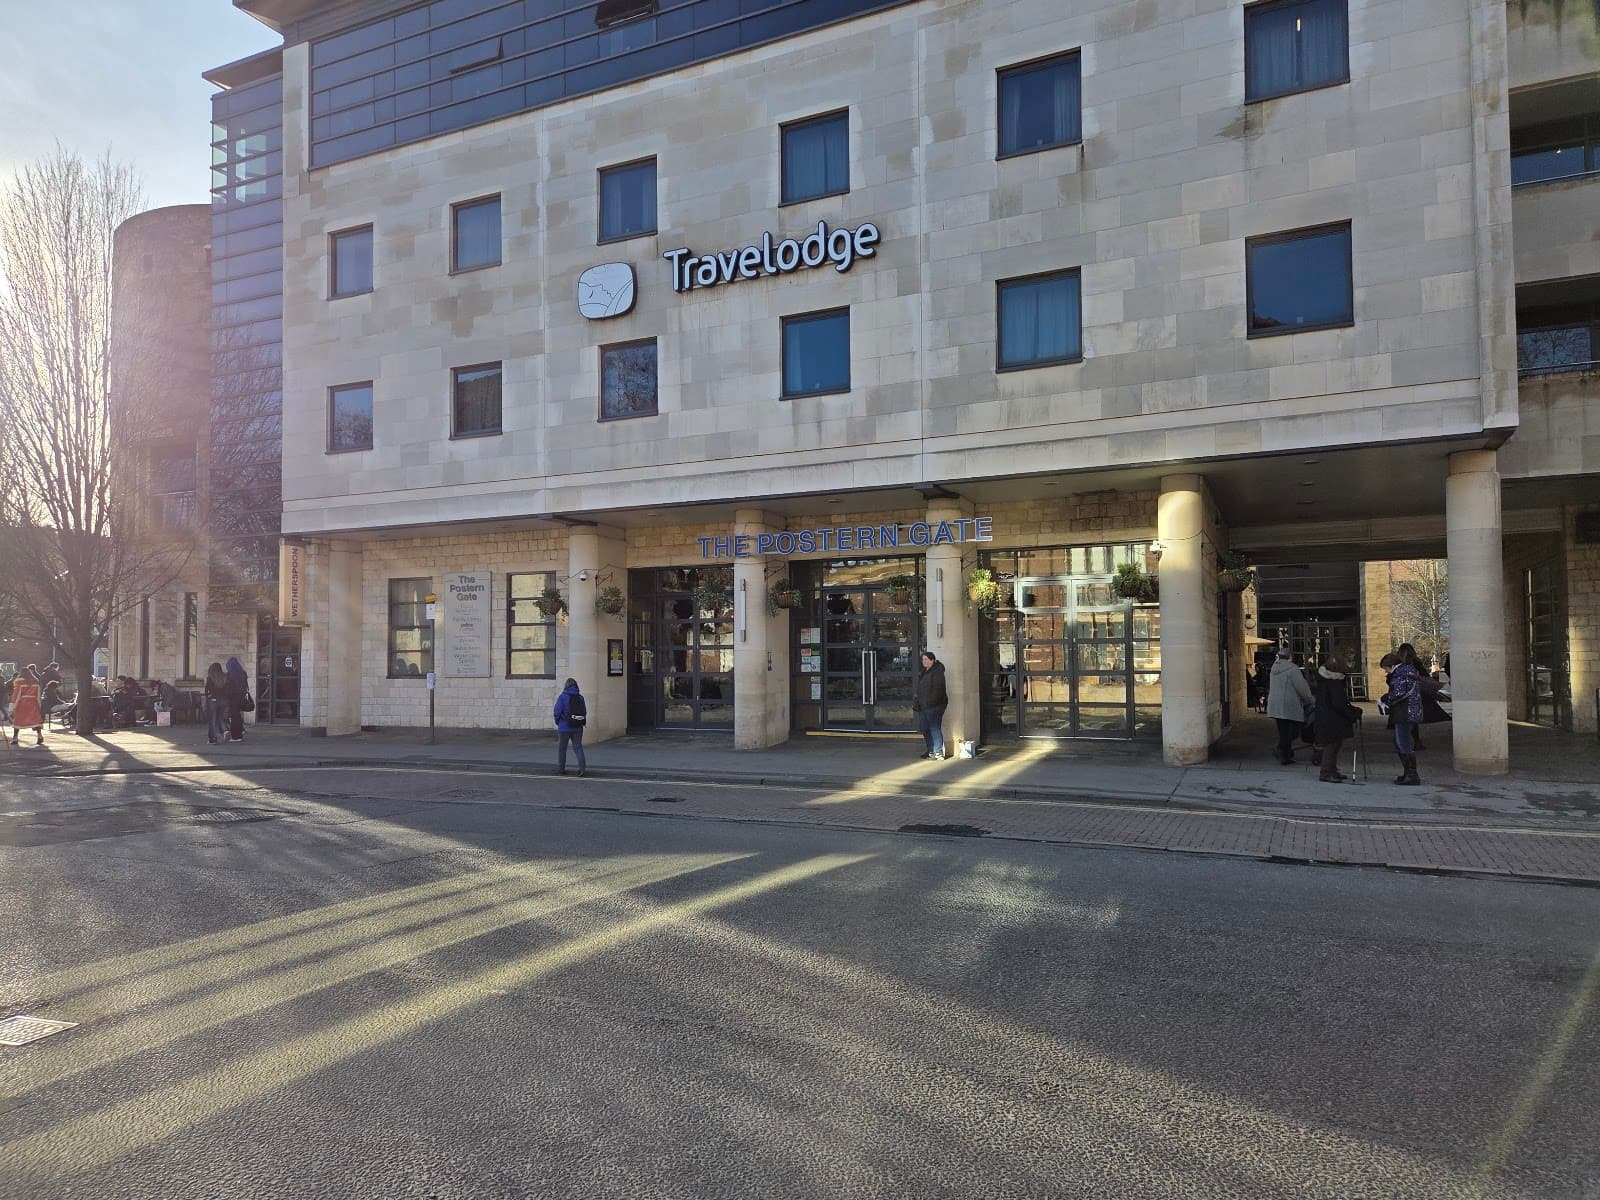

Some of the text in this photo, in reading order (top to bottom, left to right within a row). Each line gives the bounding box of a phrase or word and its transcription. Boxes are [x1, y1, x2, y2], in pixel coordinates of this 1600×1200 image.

[663, 220, 881, 293] Travelodge
[697, 516, 993, 559] THE POSTERN GATE
[291, 547, 299, 617] WETHERSPOON
[449, 584, 485, 593] Postern
[457, 575, 476, 584] The
[456, 592, 478, 601] Gate
